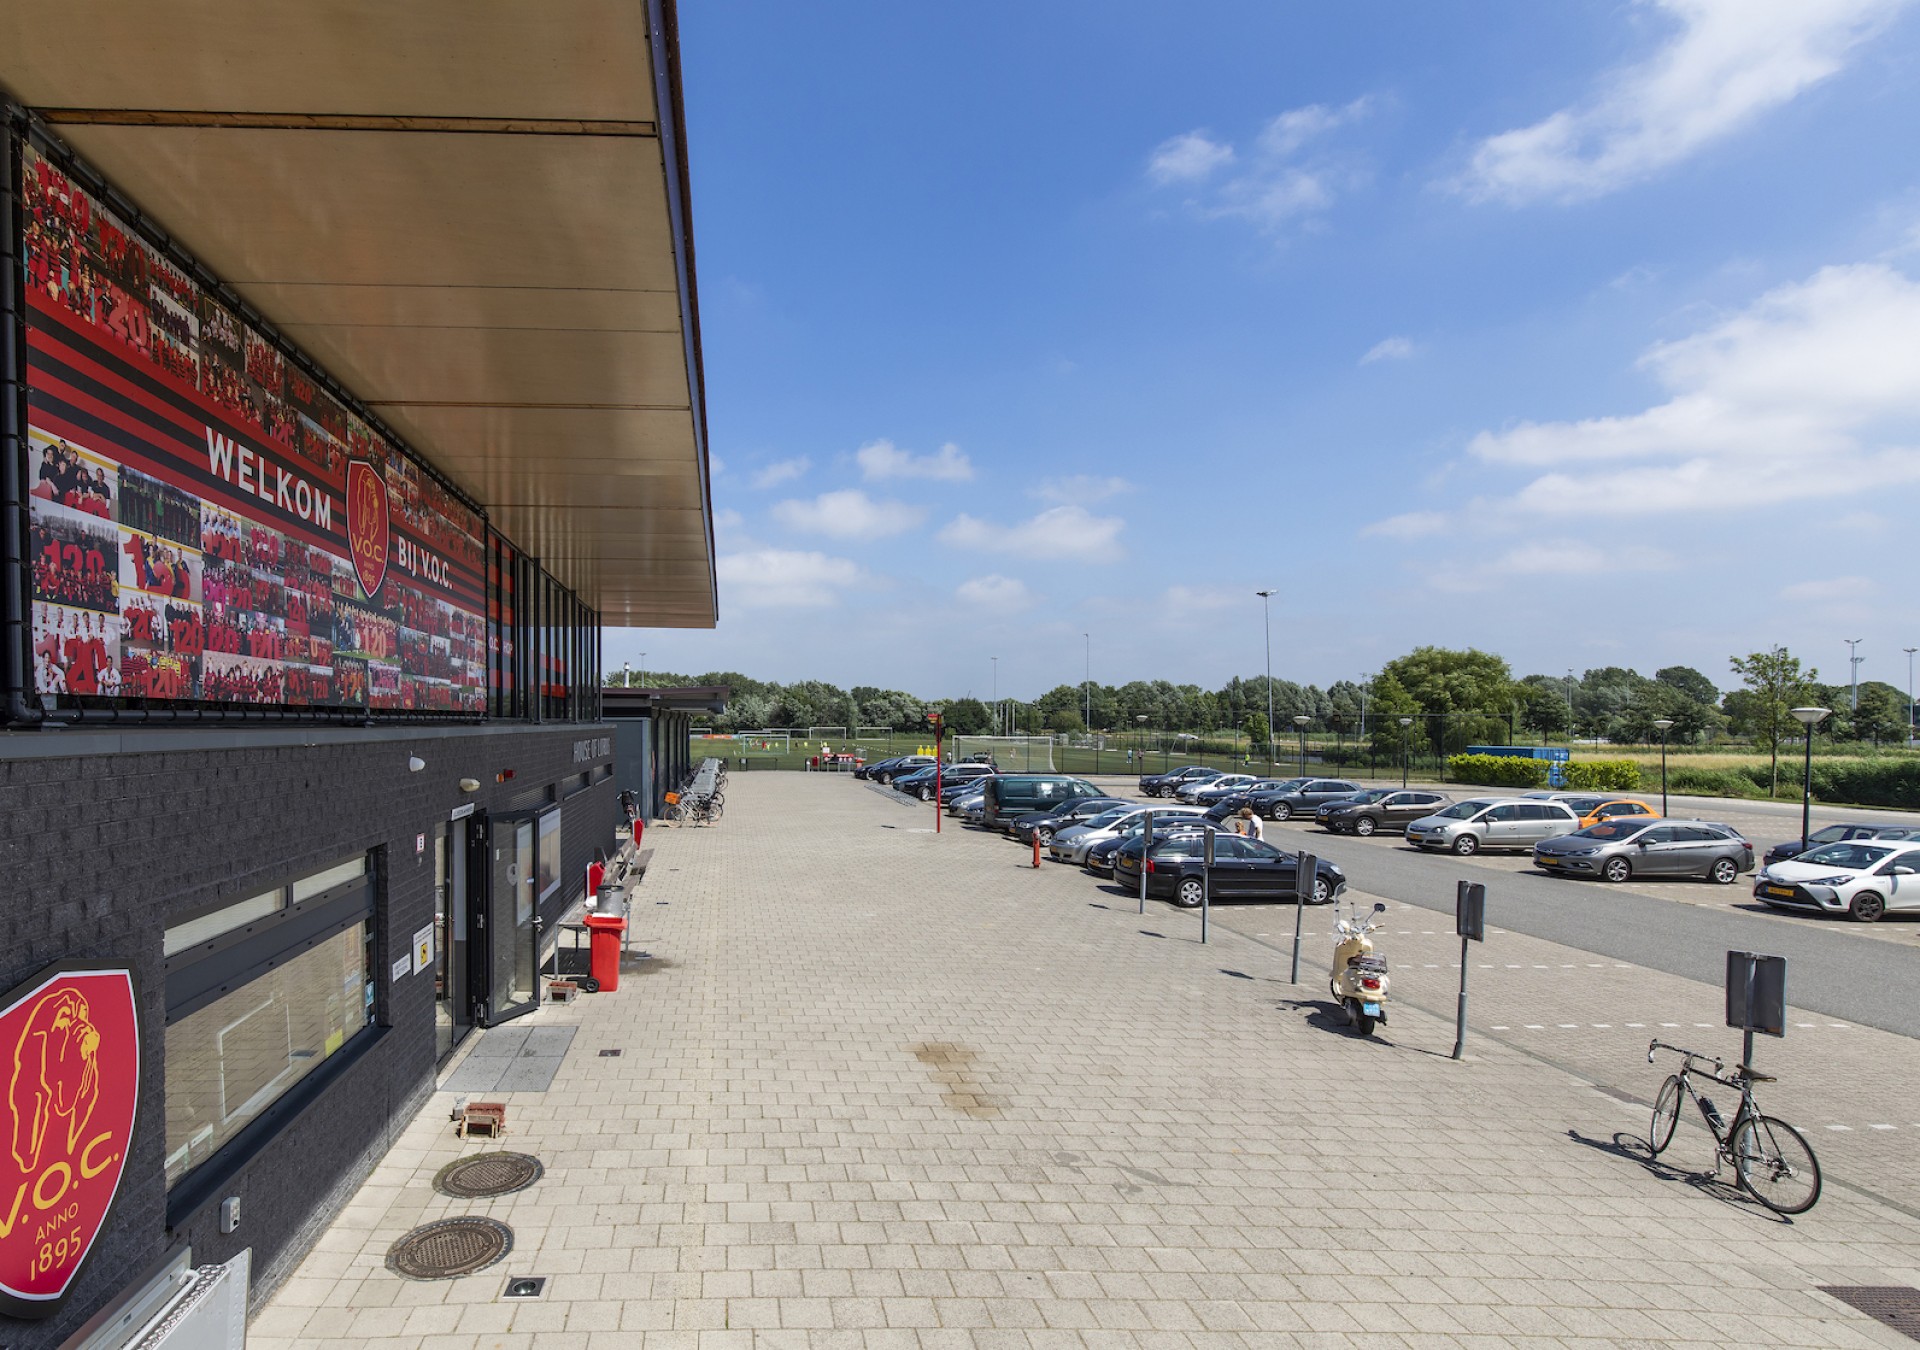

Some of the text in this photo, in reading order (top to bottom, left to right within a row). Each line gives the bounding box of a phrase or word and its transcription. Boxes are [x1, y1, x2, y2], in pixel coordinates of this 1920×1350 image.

[205, 425, 331, 531] WELKOM
[352, 532, 384, 564] V.O.C.
[398, 535, 453, 590] BIJ V.O.C.
[362, 569, 376, 588] 1895
[363, 623, 387, 659] 120
[35, 1202, 79, 1245] ANNO
[30, 1226, 82, 1281] 1895
